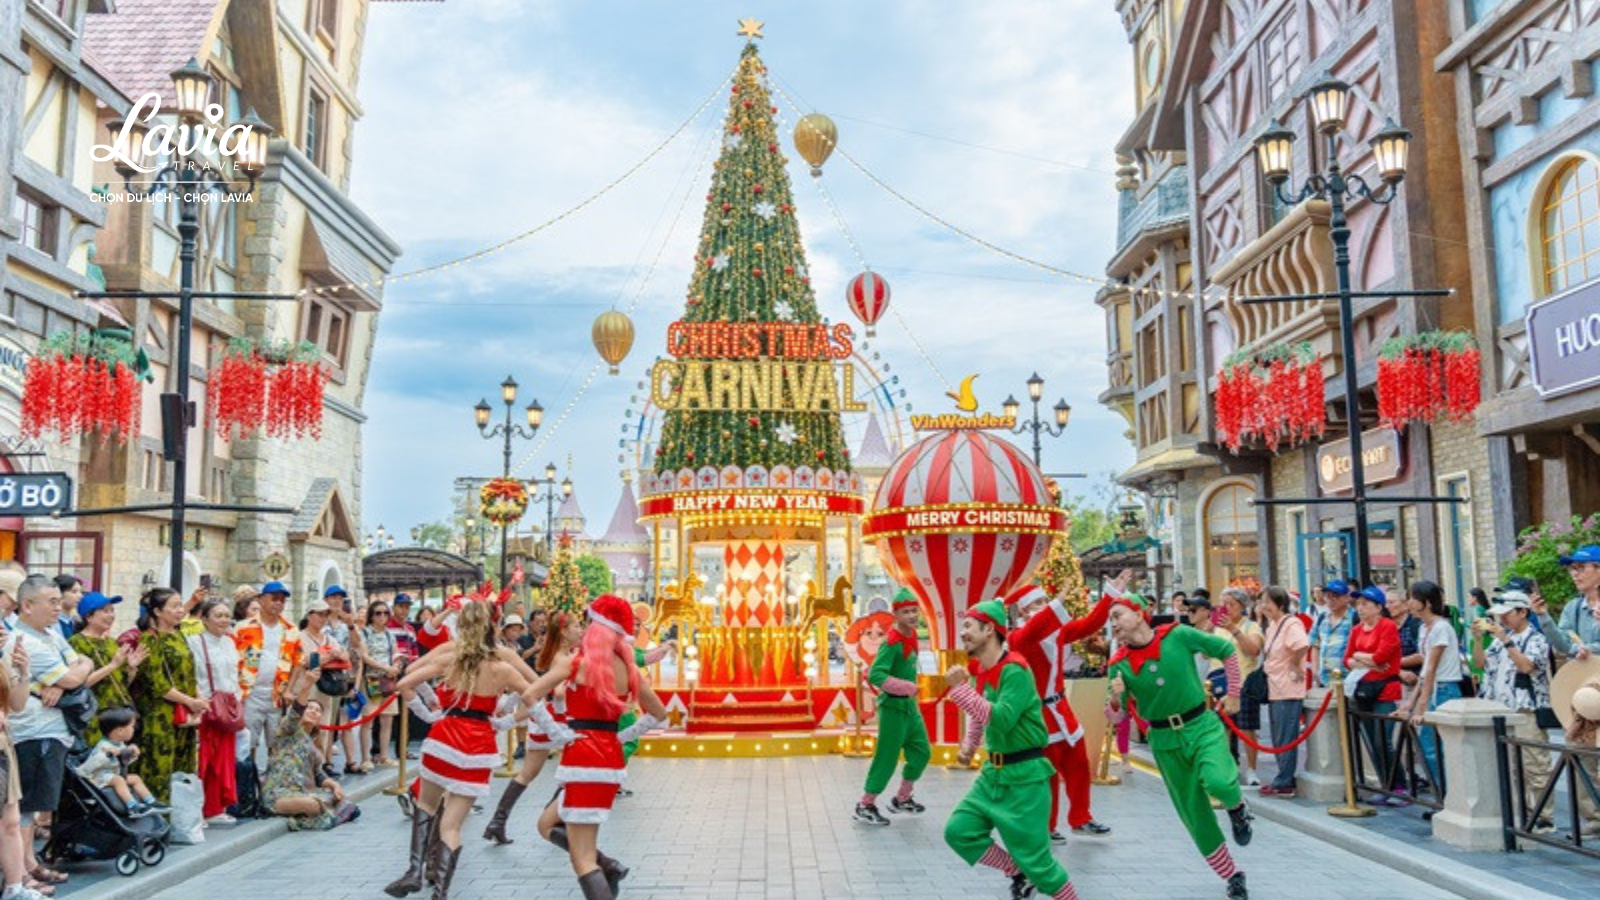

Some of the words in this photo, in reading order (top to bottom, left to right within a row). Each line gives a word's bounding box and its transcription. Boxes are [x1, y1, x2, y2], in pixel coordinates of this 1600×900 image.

[667, 321, 853, 359] CHRISTMAS
[651, 359, 868, 412] CARNIVAL
[911, 412, 1016, 431] VinWonders
[1335, 445, 1386, 475] ECART
[21, 479, 62, 507] BÒ
[673, 495, 729, 511] HAPPY
[735, 494, 780, 509] NEW
[783, 495, 829, 511] YEAR
[907, 511, 960, 526] MERRY
[964, 510, 1051, 526] CHRISTMAS
